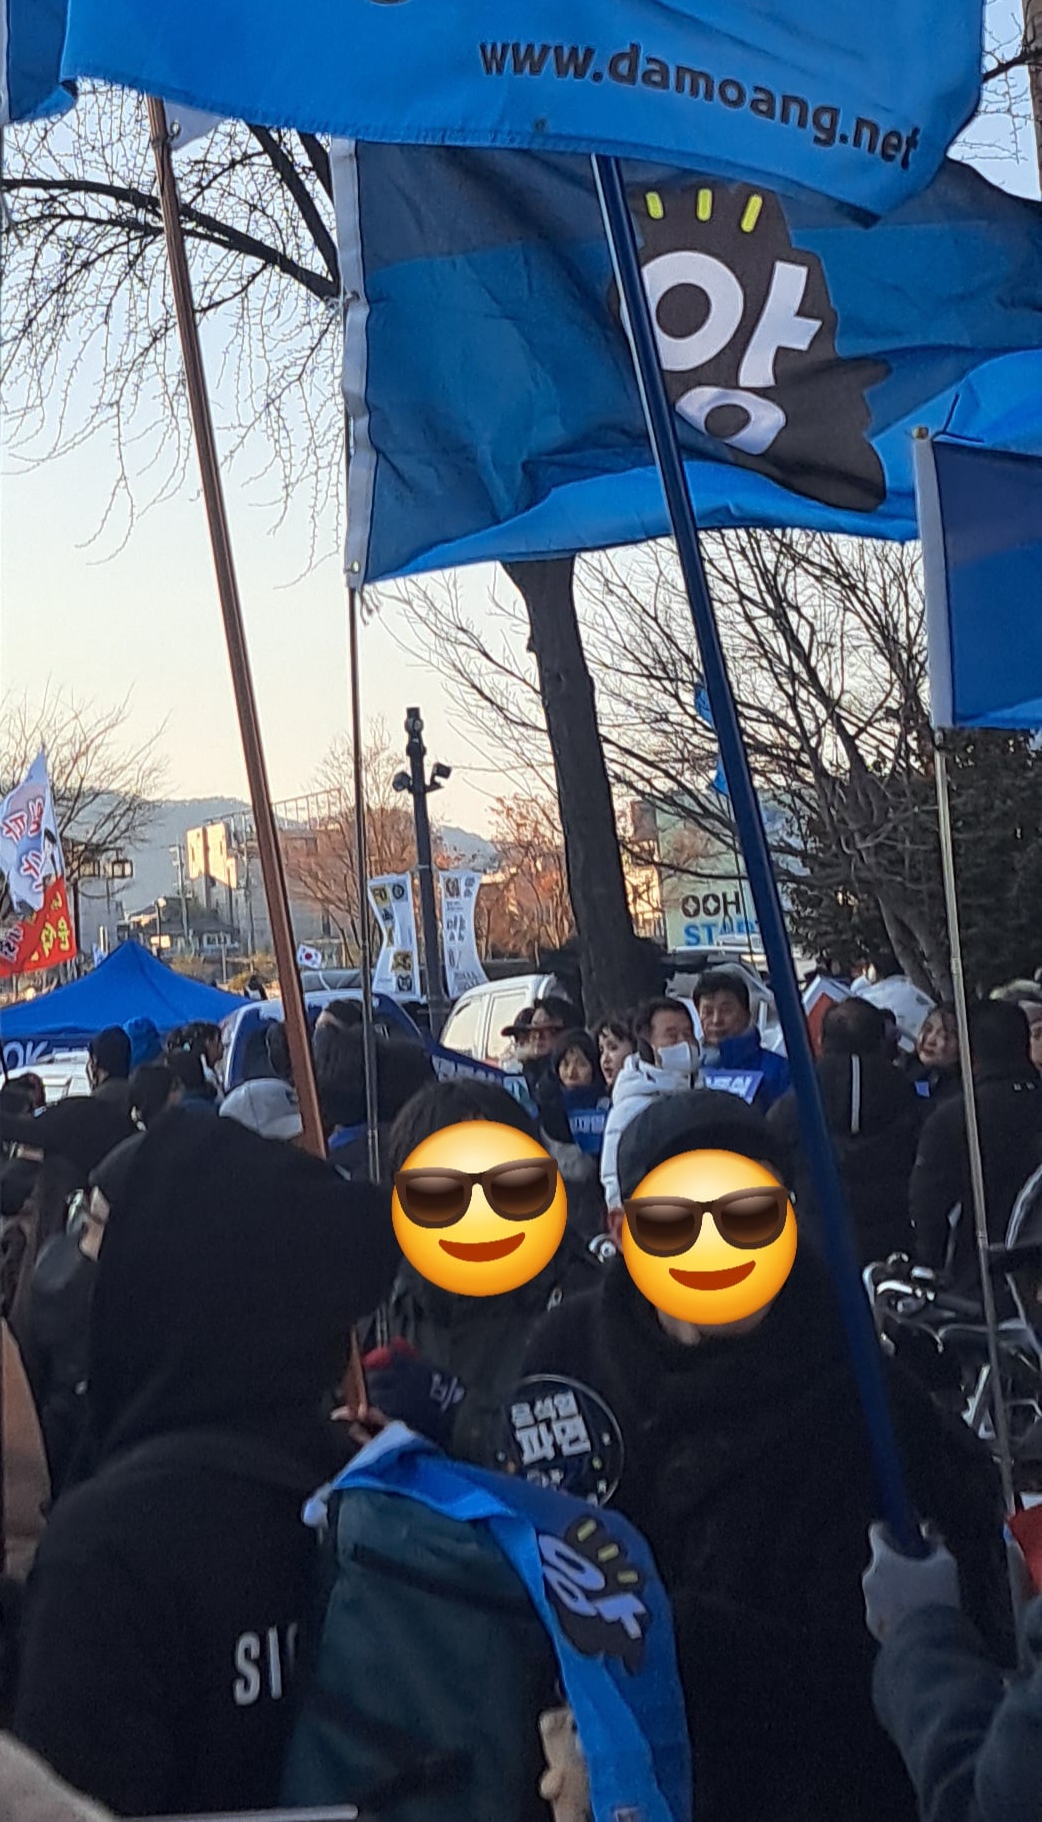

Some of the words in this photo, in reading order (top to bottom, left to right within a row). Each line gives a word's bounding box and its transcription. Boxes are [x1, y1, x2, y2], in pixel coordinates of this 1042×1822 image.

[479, 42, 920, 171] www.damoang.net
[621, 250, 822, 456] 앙
[515, 1415, 592, 1466] 파면
